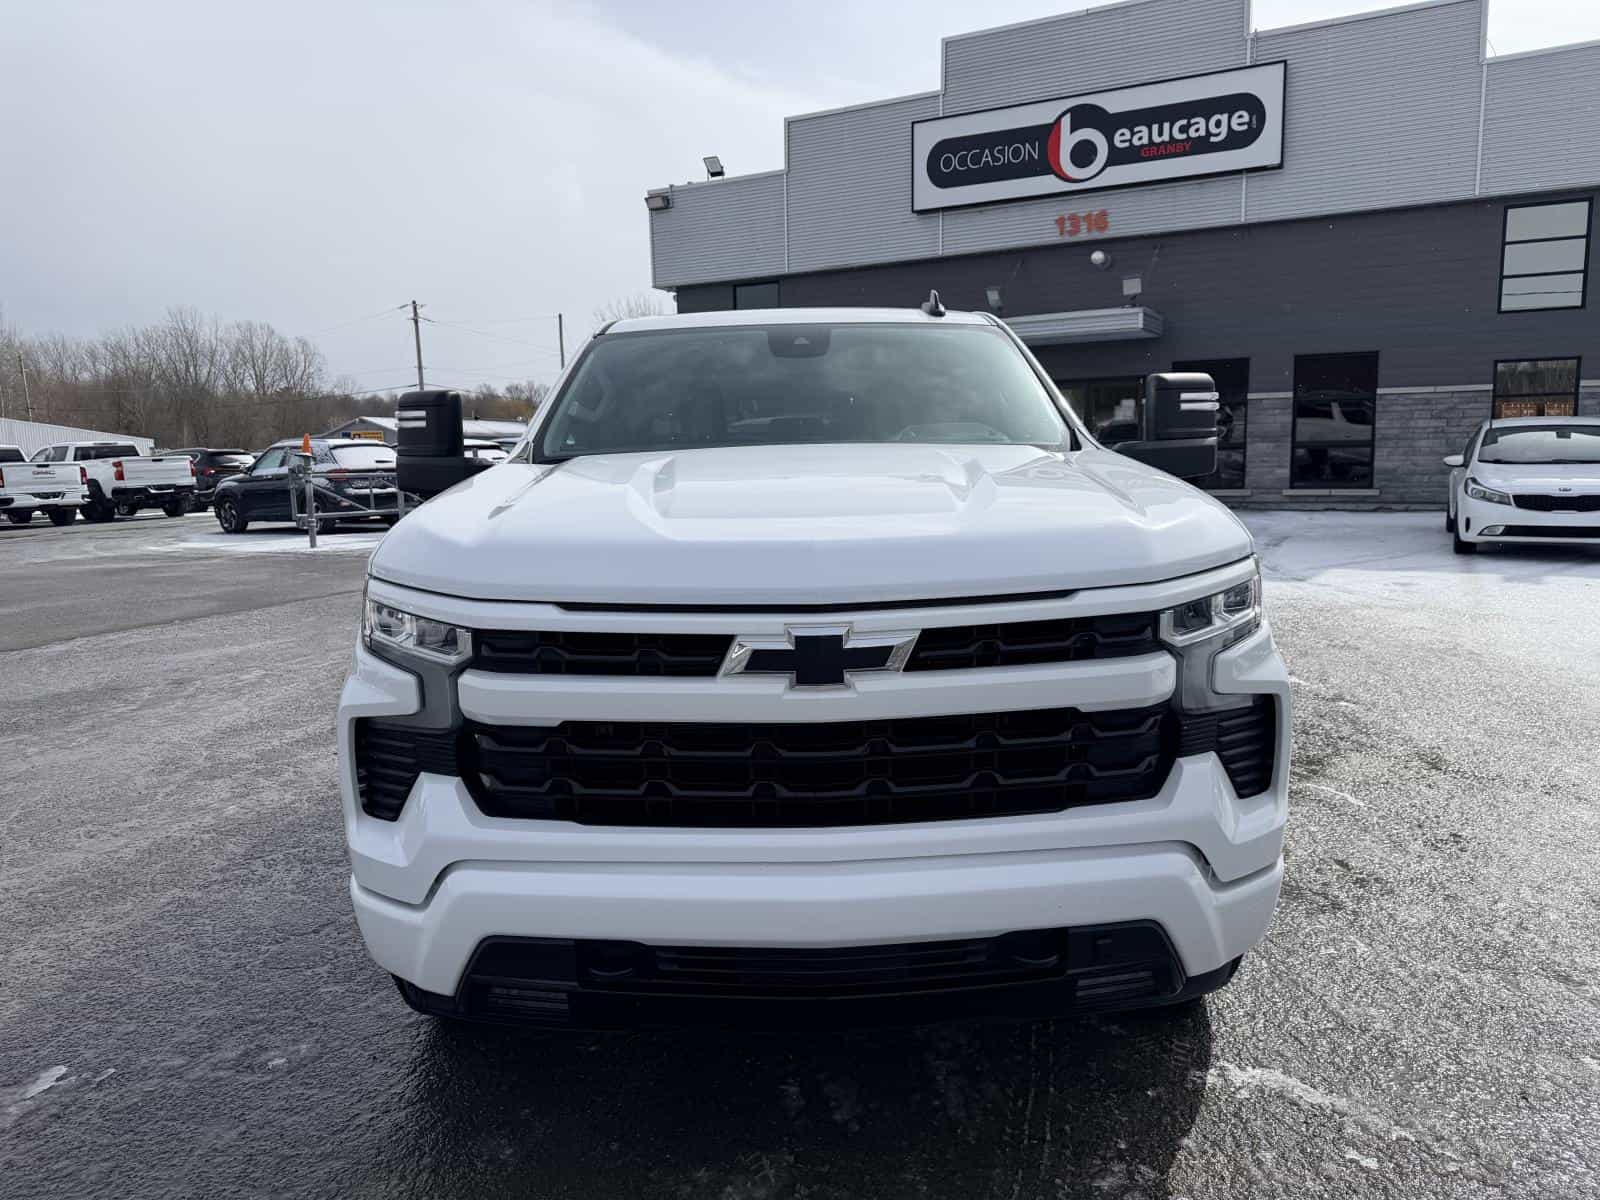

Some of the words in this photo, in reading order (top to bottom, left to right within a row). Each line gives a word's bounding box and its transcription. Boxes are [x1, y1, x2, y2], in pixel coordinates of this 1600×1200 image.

[940, 141, 1039, 172] OCCASION
[1141, 142, 1192, 157] GRANBY
[1056, 209, 1109, 237] 1316
